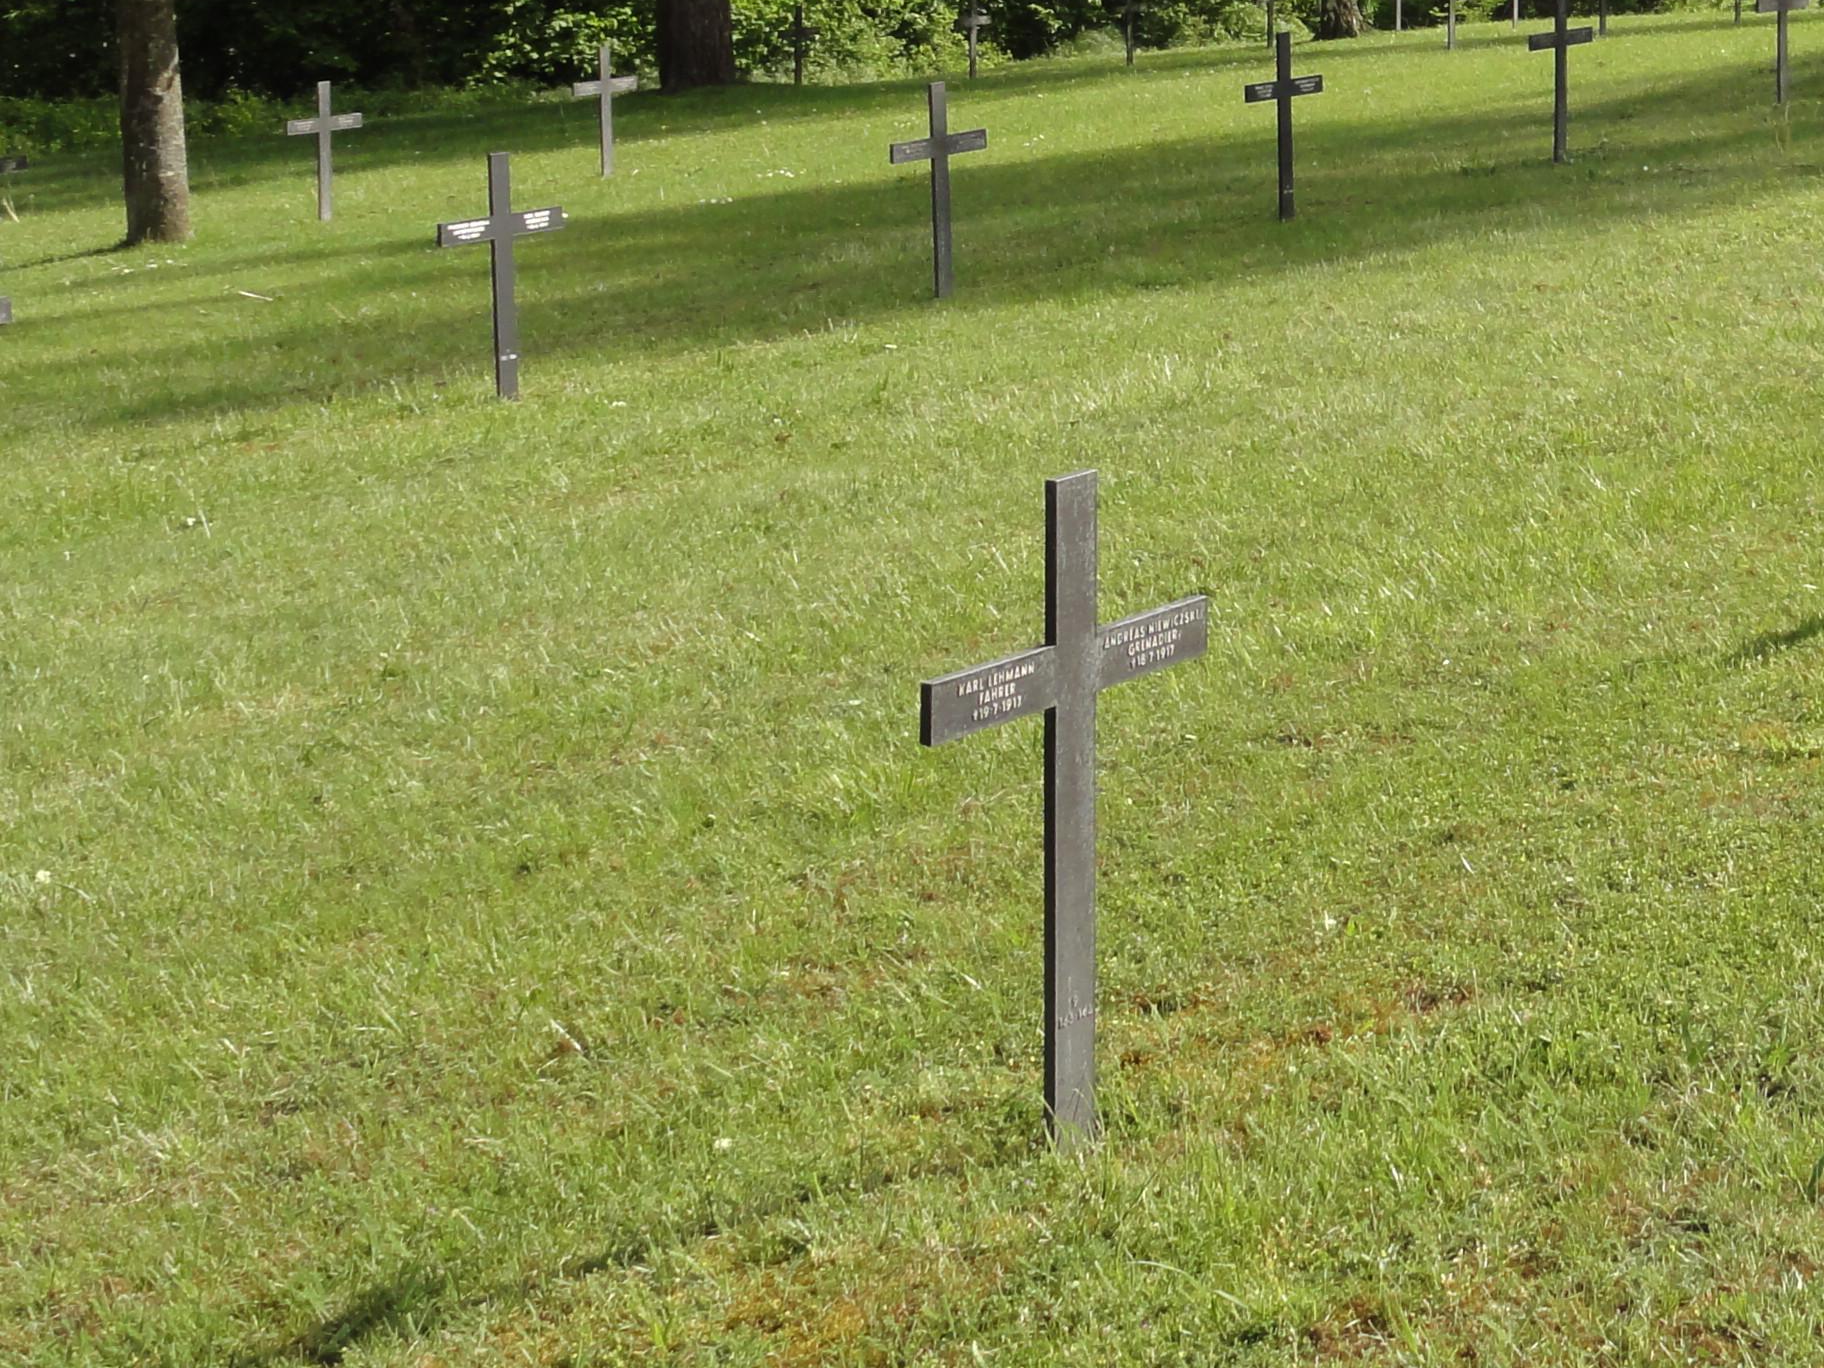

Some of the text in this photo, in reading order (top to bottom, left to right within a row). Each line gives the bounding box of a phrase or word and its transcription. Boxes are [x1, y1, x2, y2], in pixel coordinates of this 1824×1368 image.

[1104, 625, 1145, 649] ANDREAS
[1128, 629, 1177, 656] GRENADIER
[958, 662, 1035, 697] KARL LEHMANN
[979, 682, 1016, 705] FAHRER
